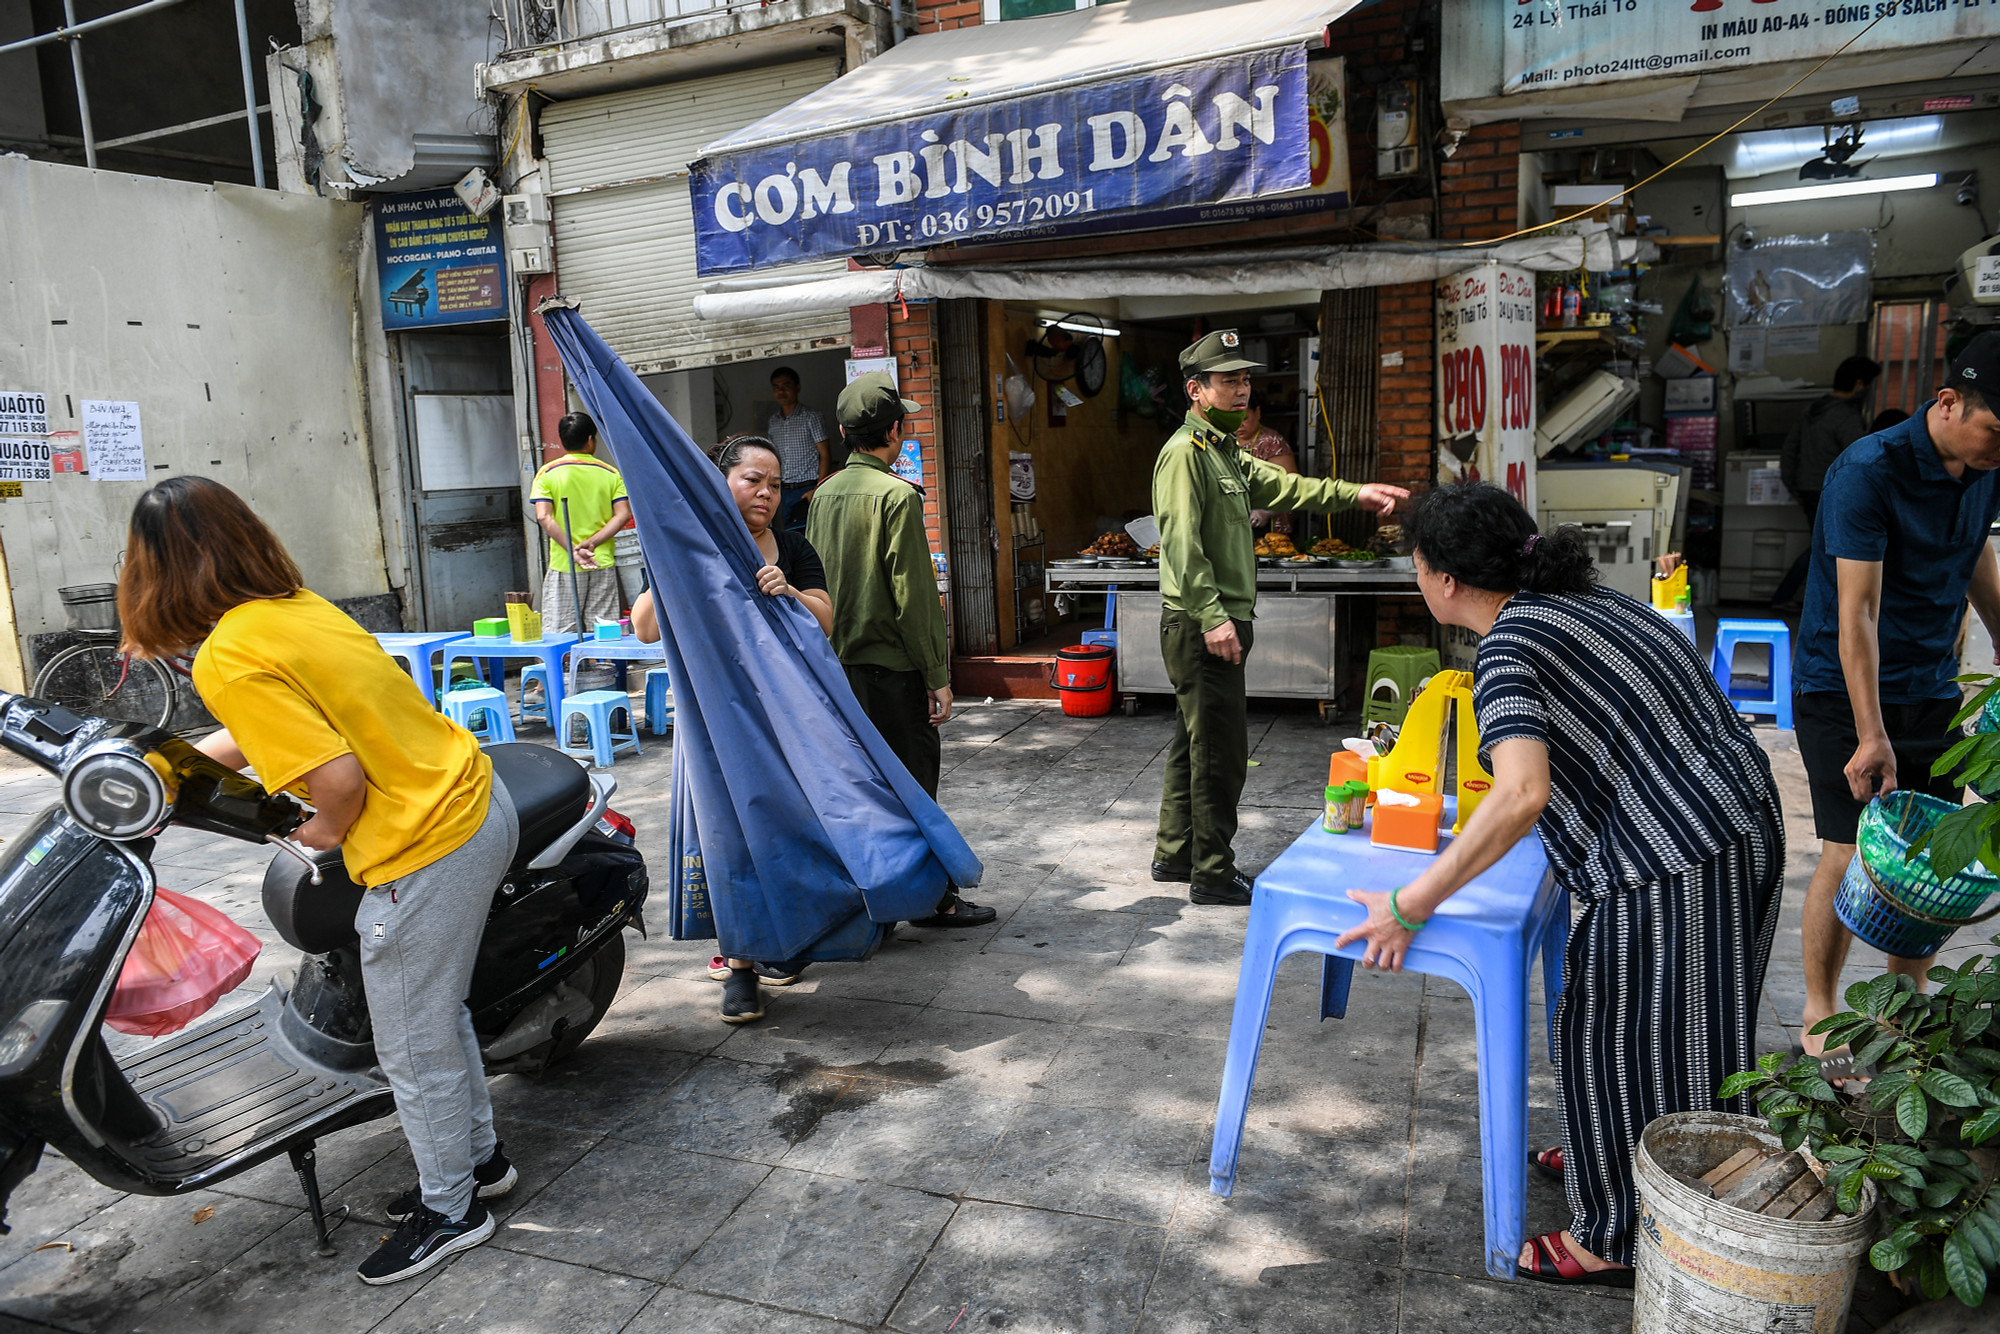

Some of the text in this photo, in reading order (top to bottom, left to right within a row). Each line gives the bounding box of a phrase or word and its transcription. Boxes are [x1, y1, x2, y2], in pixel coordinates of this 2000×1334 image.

[1512, 13, 1534, 28] 24
[1567, 1, 1607, 20] Thái
[1701, 23, 1717, 40] IN
[1722, 17, 1757, 39] MÀU
[1825, 2, 1870, 25] ĐÓNG
[1521, 46, 1750, 84] Mail: photo24ltt@gmail.com
[714, 161, 855, 233] CƠM
[873, 123, 1064, 207] BÌNH
[1087, 83, 1280, 172] DÂN
[424, 198, 437, 209] VÀ
[857, 188, 1097, 247] ĐT: 036 9572091
[1306, 199, 1315, 207] 17
[1317, 198, 1326, 207] 17
[403, 252, 431, 262] ORGAN
[436, 249, 462, 259] PIANO
[1441, 344, 1487, 434] PHO
[1500, 344, 1532, 431] PHO
[12, 422, 28, 433] 115
[31, 422, 47, 433] 838
[16, 468, 32, 479] 115
[34, 469, 50, 479] 838
